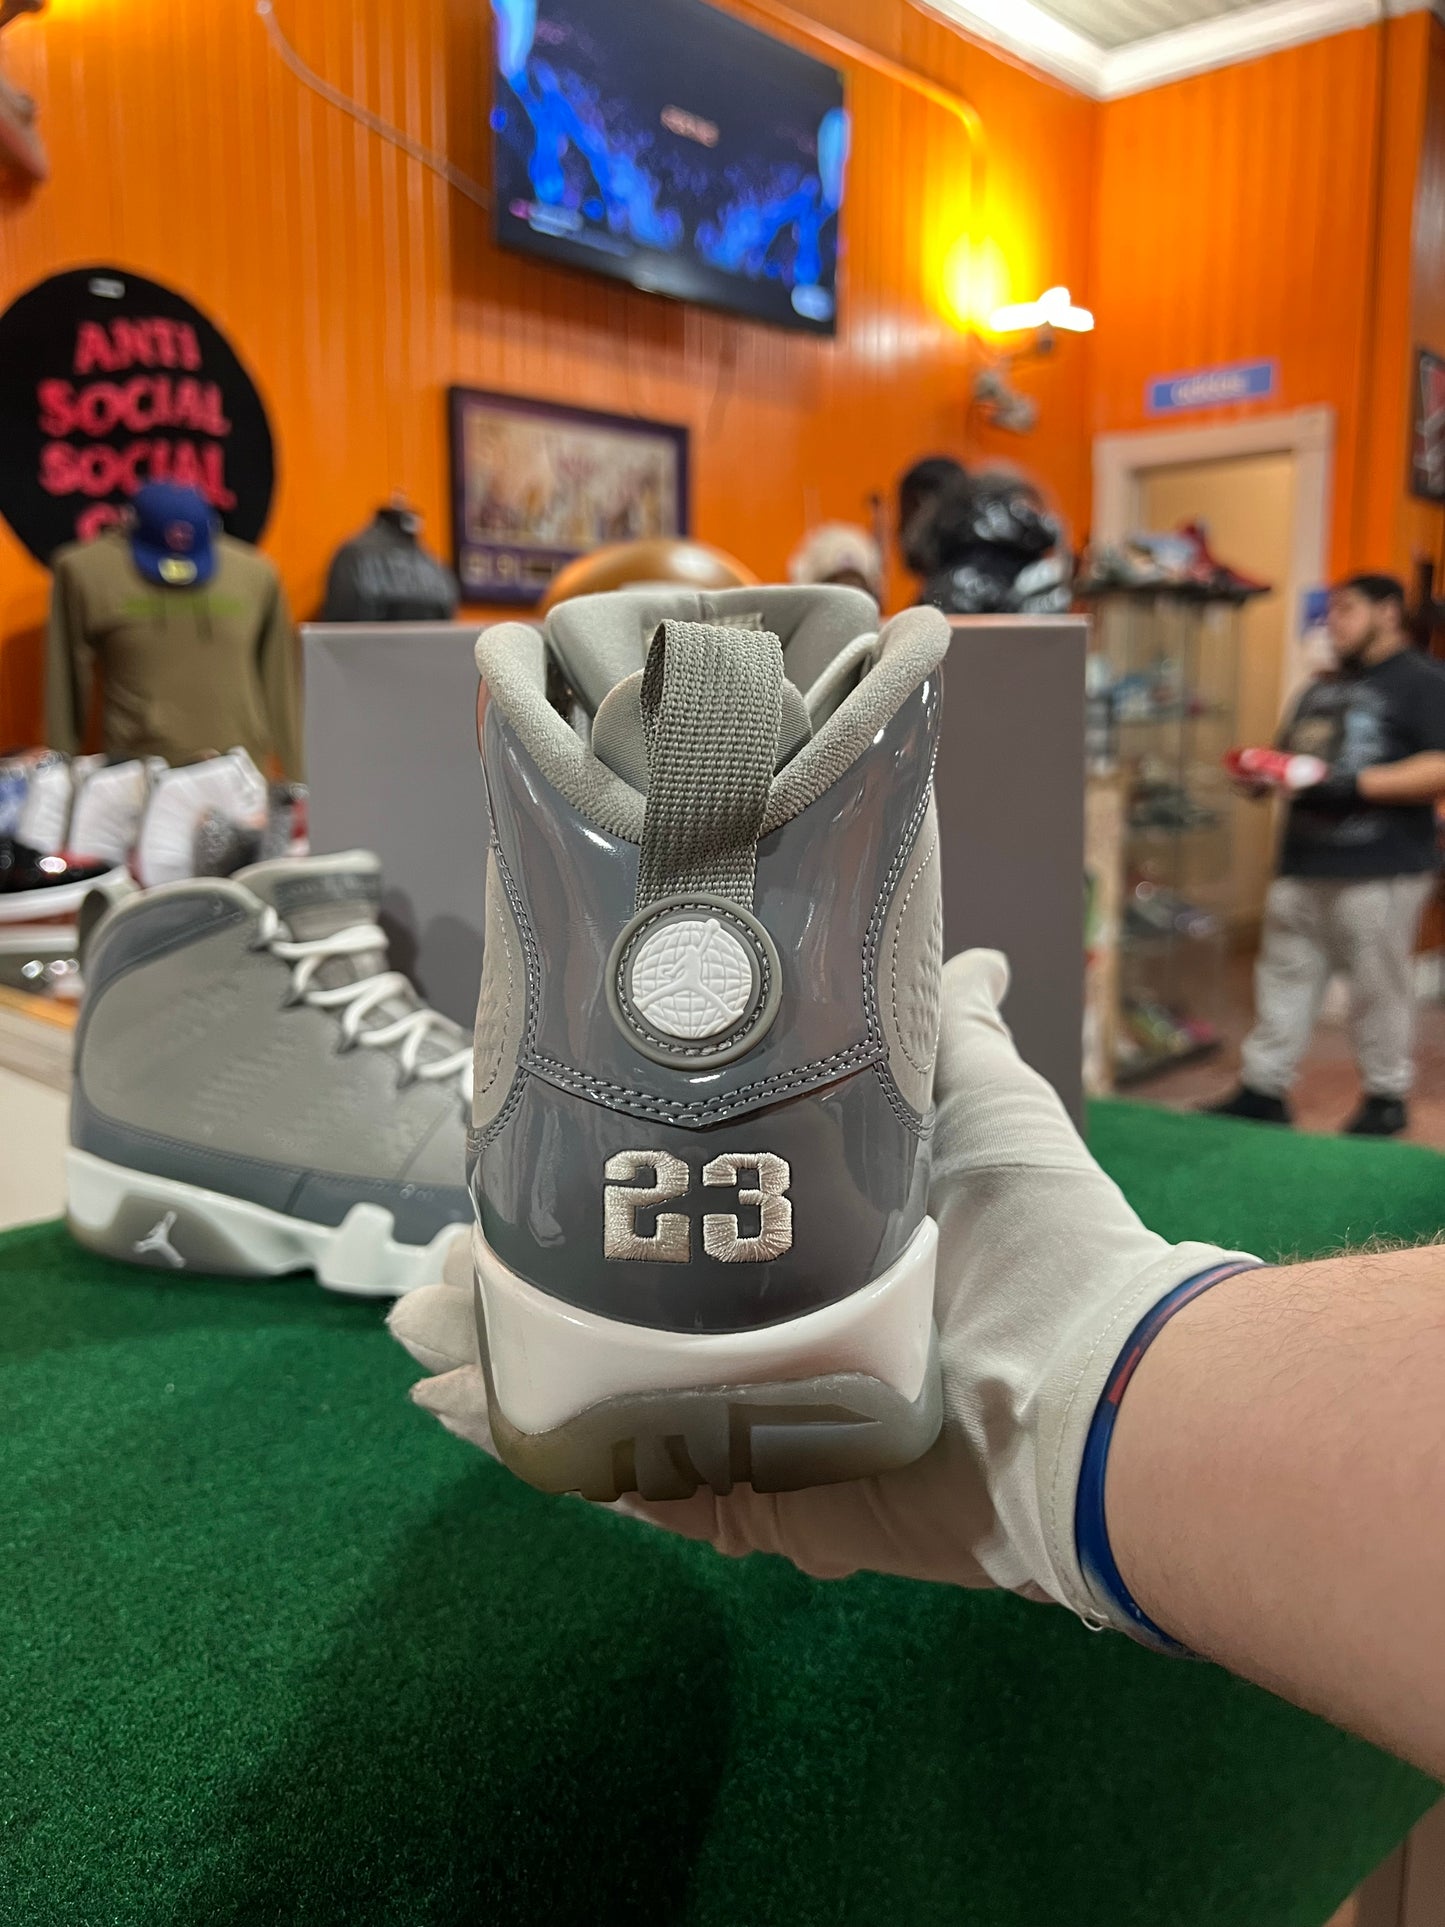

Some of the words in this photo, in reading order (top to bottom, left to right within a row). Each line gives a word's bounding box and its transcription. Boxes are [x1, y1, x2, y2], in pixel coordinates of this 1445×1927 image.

[74, 316, 201, 375] ANTI
[37, 374, 231, 437] SOCIAL
[604, 1150, 792, 1263] 23
